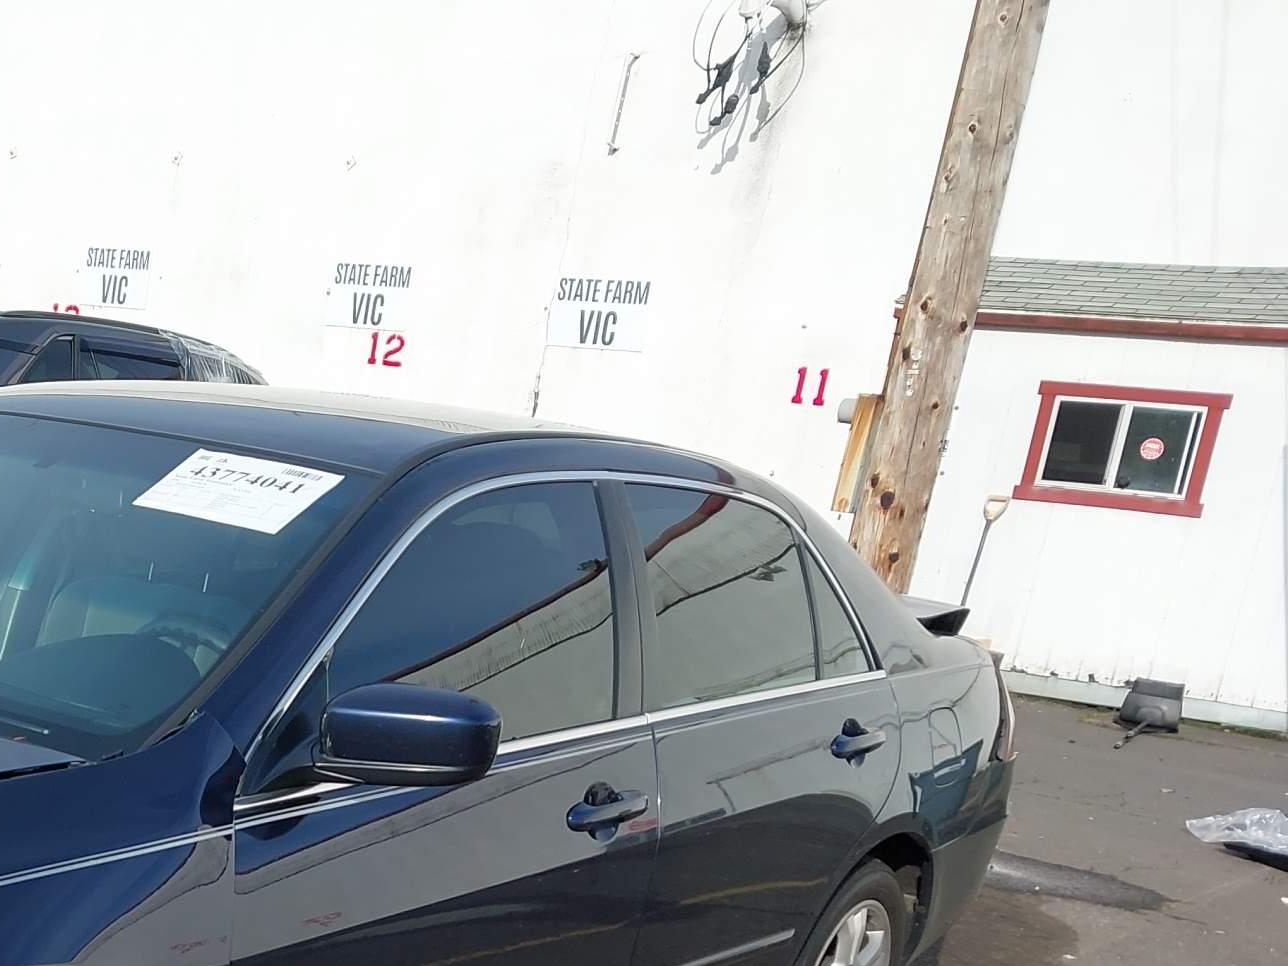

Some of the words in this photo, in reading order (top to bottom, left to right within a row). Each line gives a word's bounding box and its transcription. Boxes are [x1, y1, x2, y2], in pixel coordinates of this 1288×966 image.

[86, 247, 117, 269] STATE
[119, 250, 151, 271] FARM
[101, 274, 128, 305] VIC
[335, 263, 370, 286] STATE
[373, 265, 412, 288] FARM
[558, 277, 602, 303] STATE
[604, 280, 651, 305] FARM
[352, 292, 384, 326] VIC
[579, 309, 618, 346] VIC
[367, 331, 405, 367] 12
[791, 366, 830, 406] 11
[190, 465, 305, 494] 43774041
